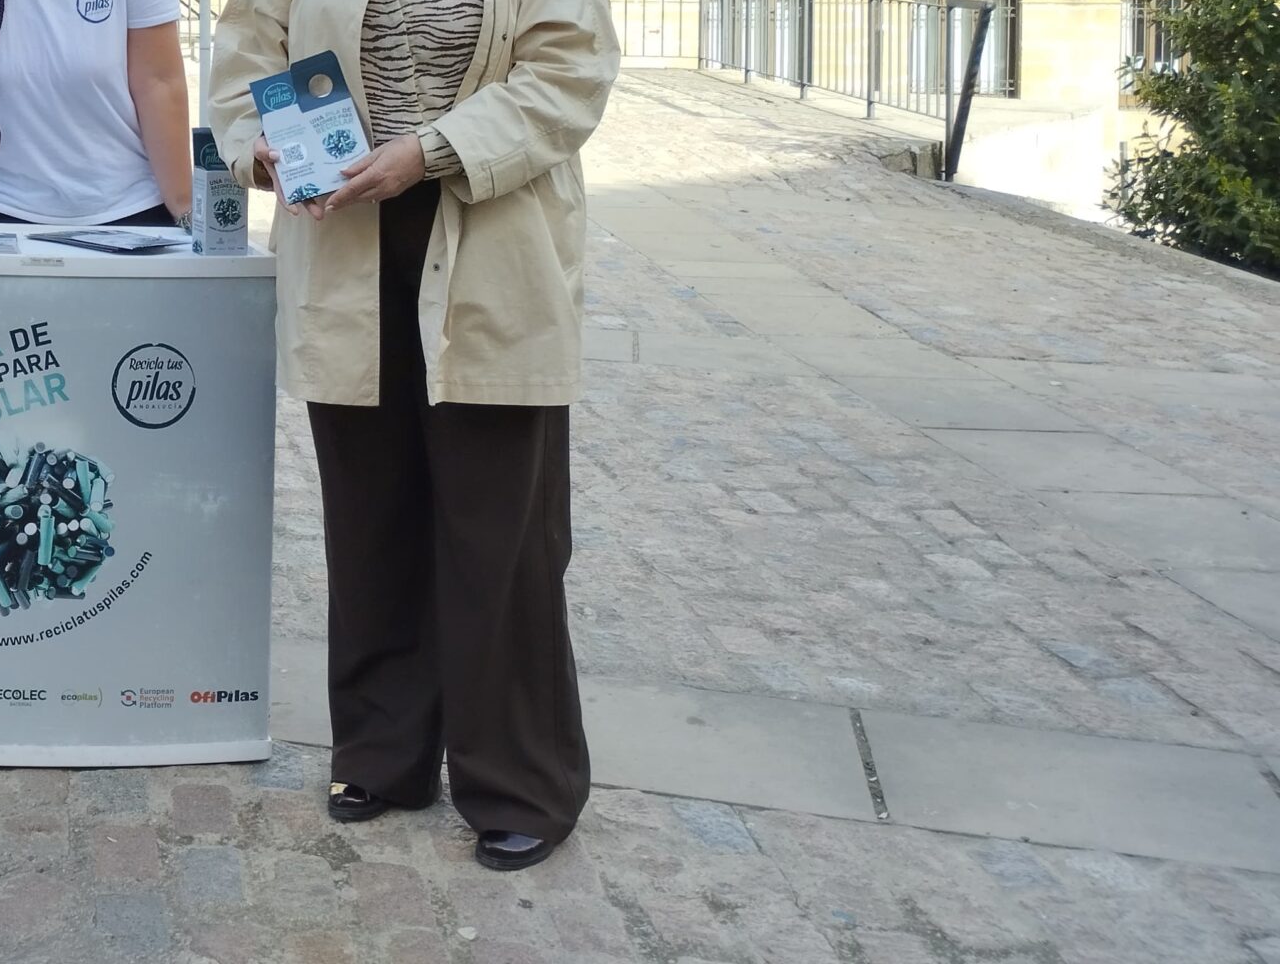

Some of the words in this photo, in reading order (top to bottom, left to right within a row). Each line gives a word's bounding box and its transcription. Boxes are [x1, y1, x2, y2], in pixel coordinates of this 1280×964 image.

[9, 321, 52, 353] DE
[129, 356, 164, 371] Recicla
[167, 358, 183, 370] tus
[125, 371, 183, 409] pilas
[61, 692, 98, 703] ecopilas
[139, 687, 175, 697] European
[139, 694, 175, 703] Recycling
[139, 701, 173, 709] Platform
